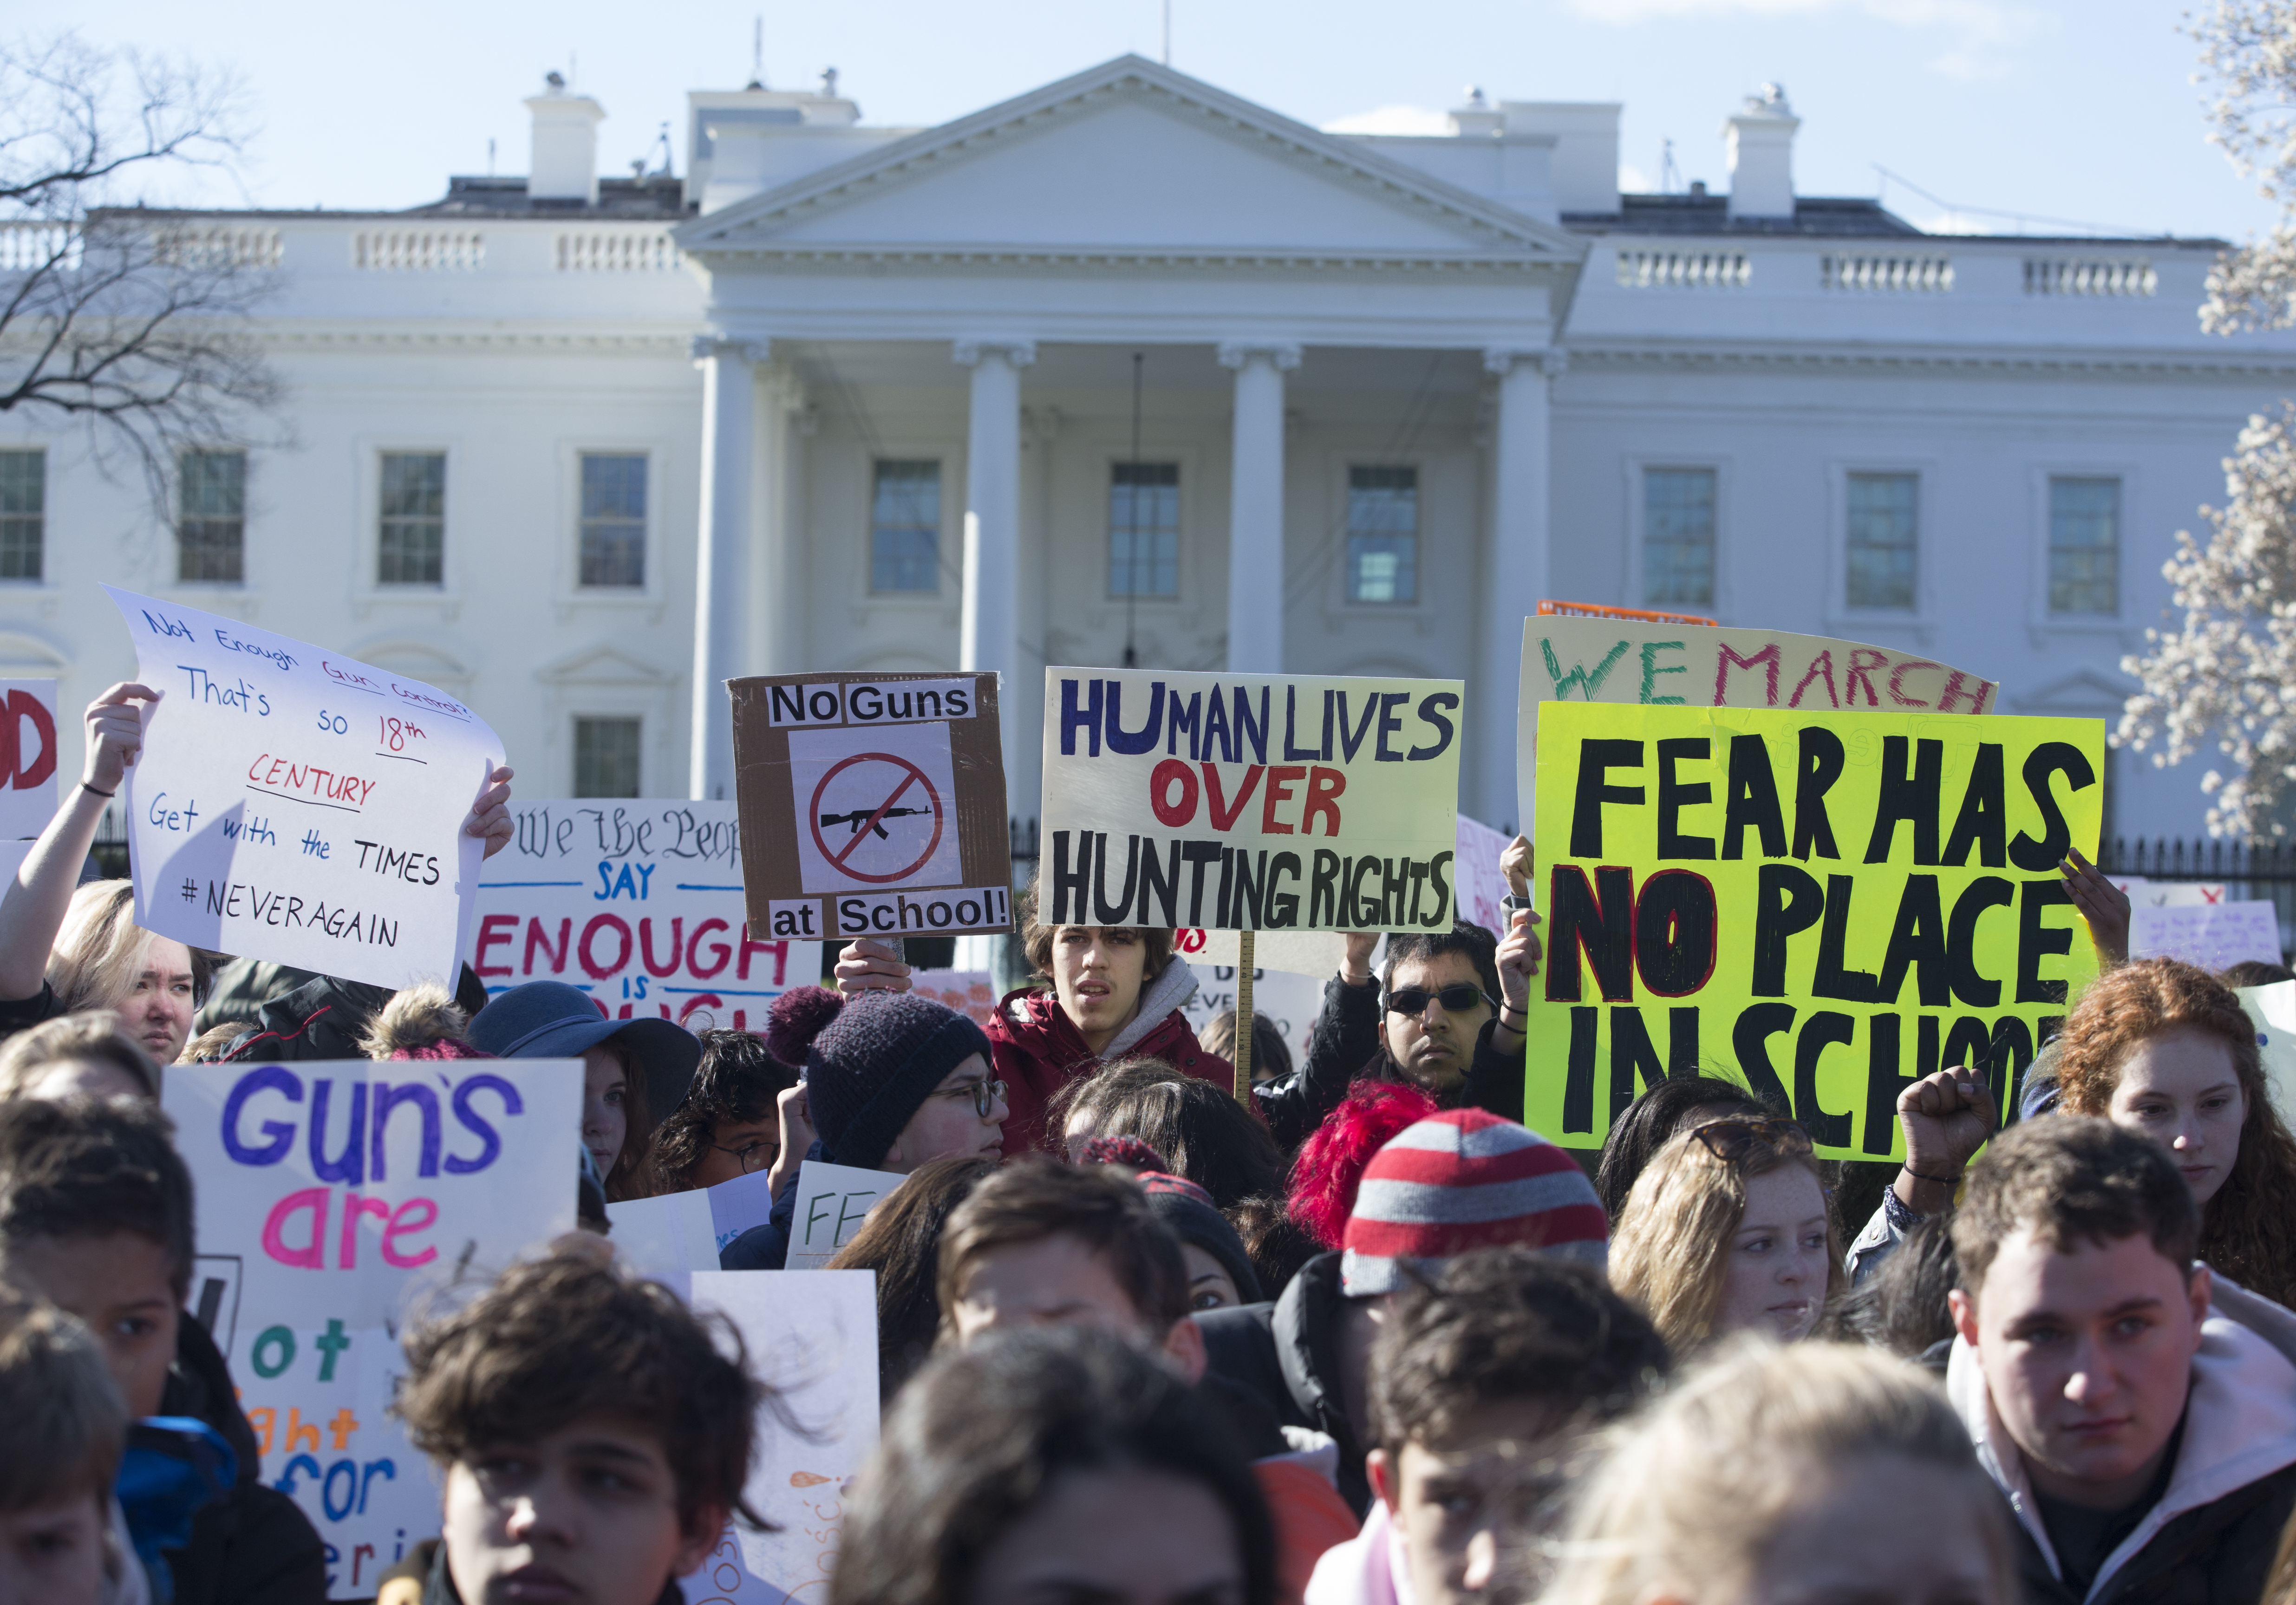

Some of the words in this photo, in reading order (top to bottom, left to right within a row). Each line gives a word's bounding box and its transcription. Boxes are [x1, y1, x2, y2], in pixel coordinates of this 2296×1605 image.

[142, 609, 195, 643] Not
[214, 628, 299, 671] Enough
[322, 661, 380, 686] Gun
[391, 683, 472, 718] Control?
[1536, 637, 1687, 705] WE
[1713, 641, 1996, 715] MARCH
[0, 688, 58, 790] D
[176, 665, 271, 717] That's
[318, 710, 348, 735] so
[379, 715, 427, 751] 18th
[771, 685, 839, 722] No
[849, 686, 969, 721] Guns
[1060, 679, 1270, 765] HUMAN
[1283, 684, 1460, 765] LIVES
[249, 754, 376, 806] CENTURY
[1150, 758, 1346, 836] OVER
[1569, 726, 1841, 863] FEAR
[1862, 736, 2096, 872] HAS
[150, 792, 199, 832] Get
[223, 809, 275, 846] with
[301, 829, 330, 859] the
[354, 840, 439, 886] TIMES
[516, 806, 573, 859] We
[576, 808, 655, 860] The
[662, 809, 741, 870] Peop
[594, 861, 656, 900] SAY
[773, 904, 815, 936] at
[840, 890, 1006, 933] School!
[1052, 830, 1301, 930] HUNTING
[1308, 848, 1454, 928] RIGHTS
[474, 913, 789, 986] ENOUGH
[1545, 863, 1718, 1003] NO
[1751, 863, 2073, 1007] PLACE
[622, 975, 649, 1000] IS
[1562, 1005, 1699, 1134] IN
[1731, 1002, 2065, 1155] SCHO
[261, 1186, 440, 1271] are
[250, 1318, 352, 1383] ot
[234, 1386, 359, 1457] ght
